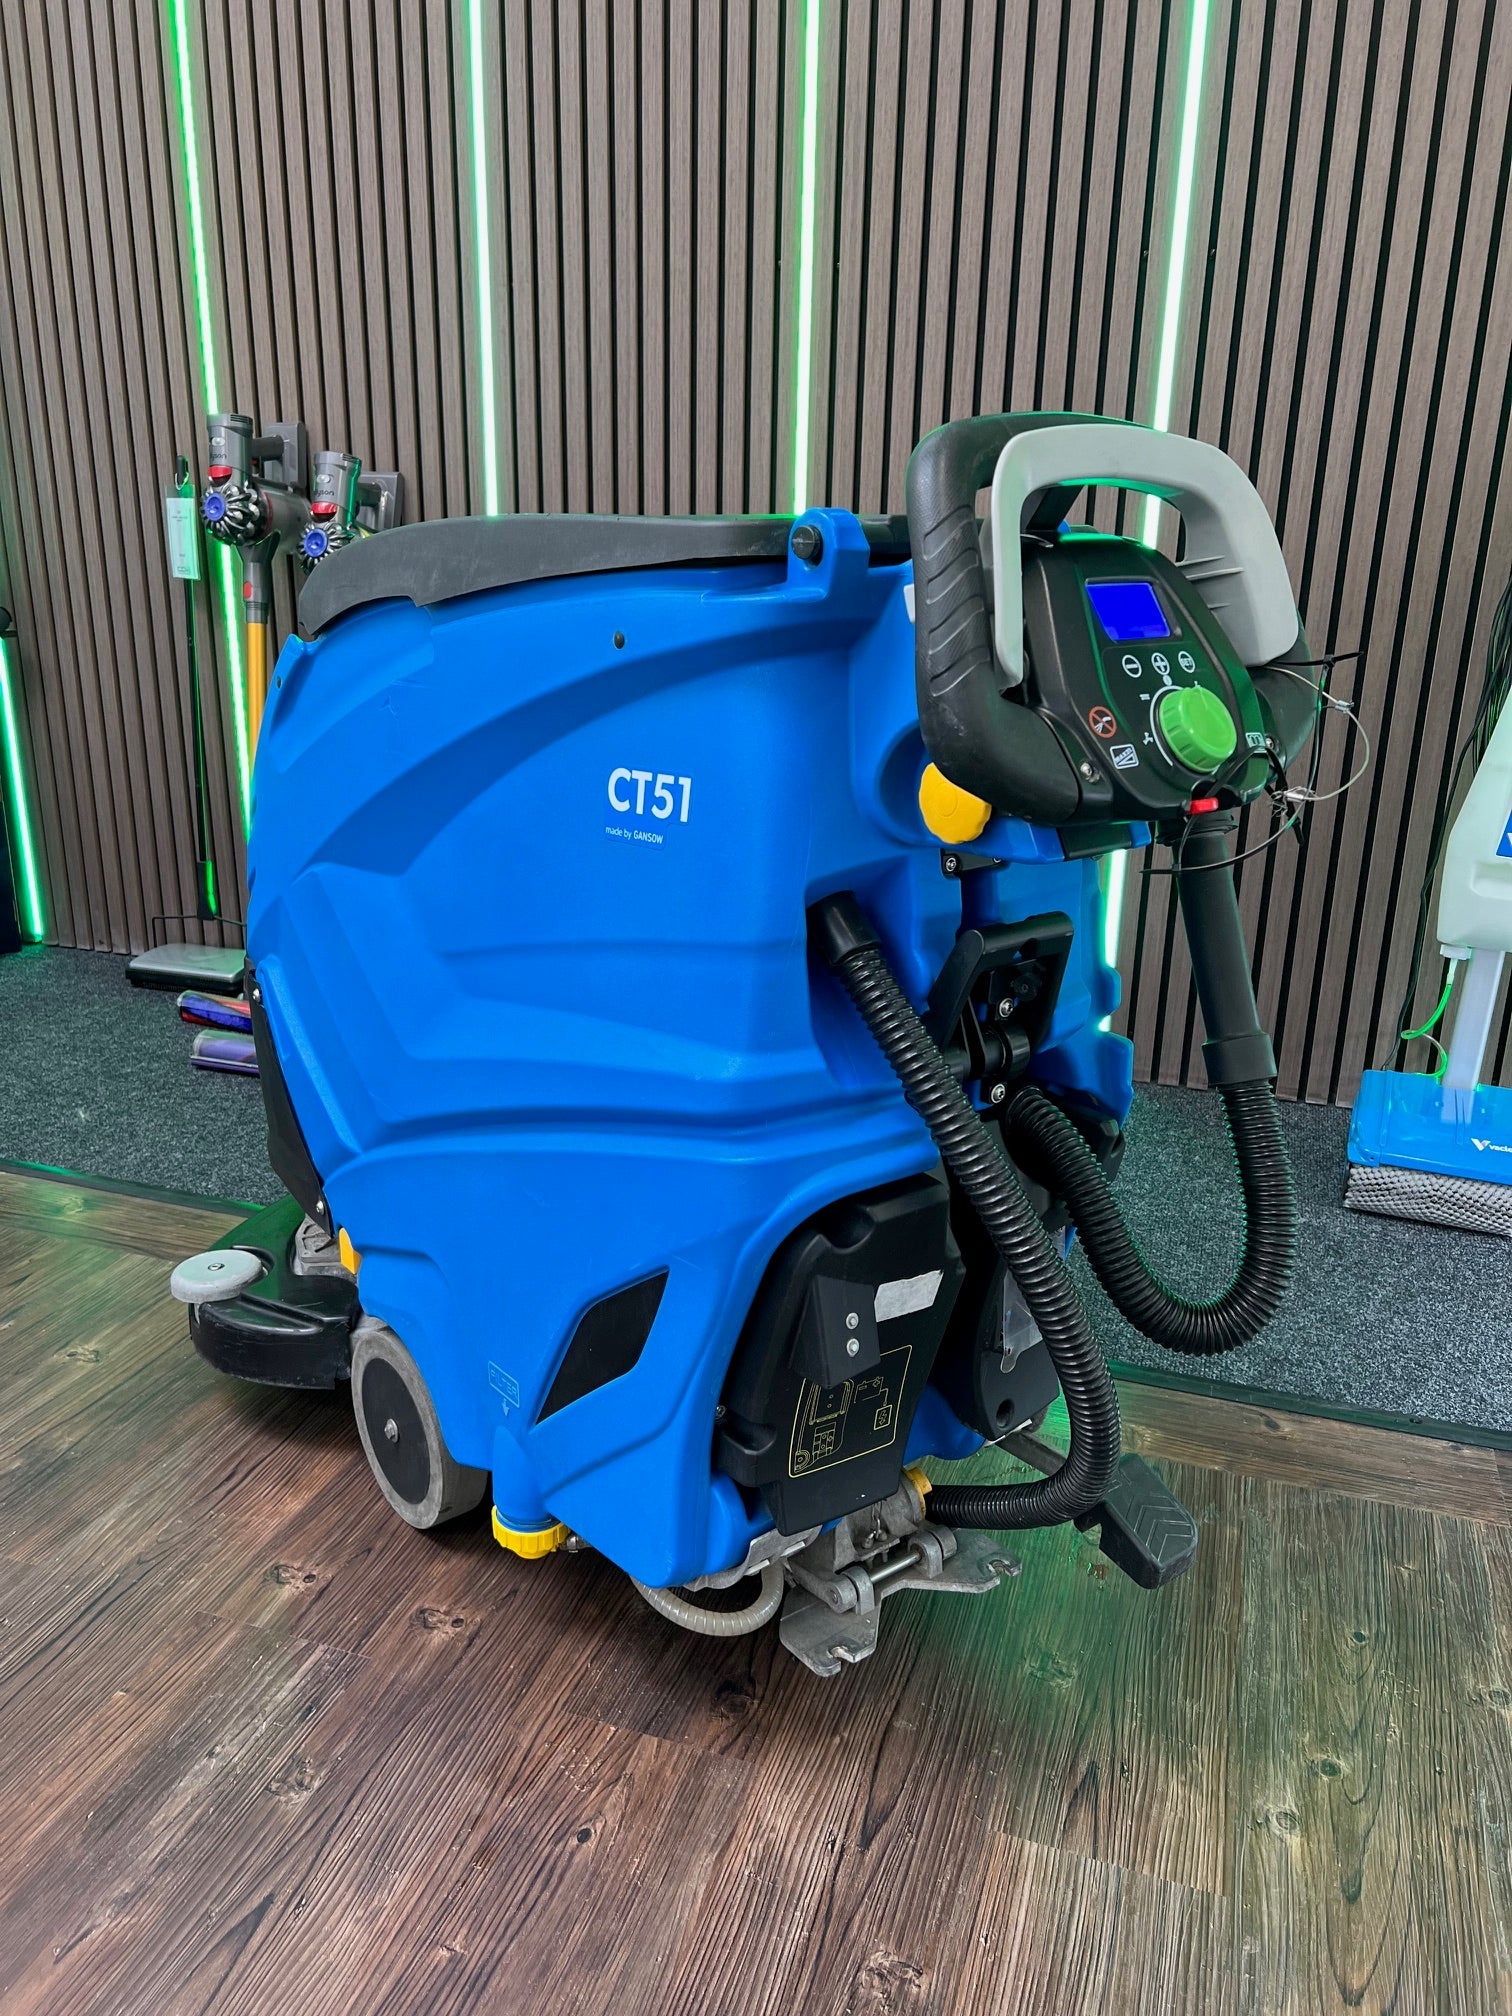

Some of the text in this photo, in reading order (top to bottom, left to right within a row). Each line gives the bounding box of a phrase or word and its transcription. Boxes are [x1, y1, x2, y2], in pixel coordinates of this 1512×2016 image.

[608, 767, 692, 823] CT51
[605, 826, 664, 845] made by GANSOW
